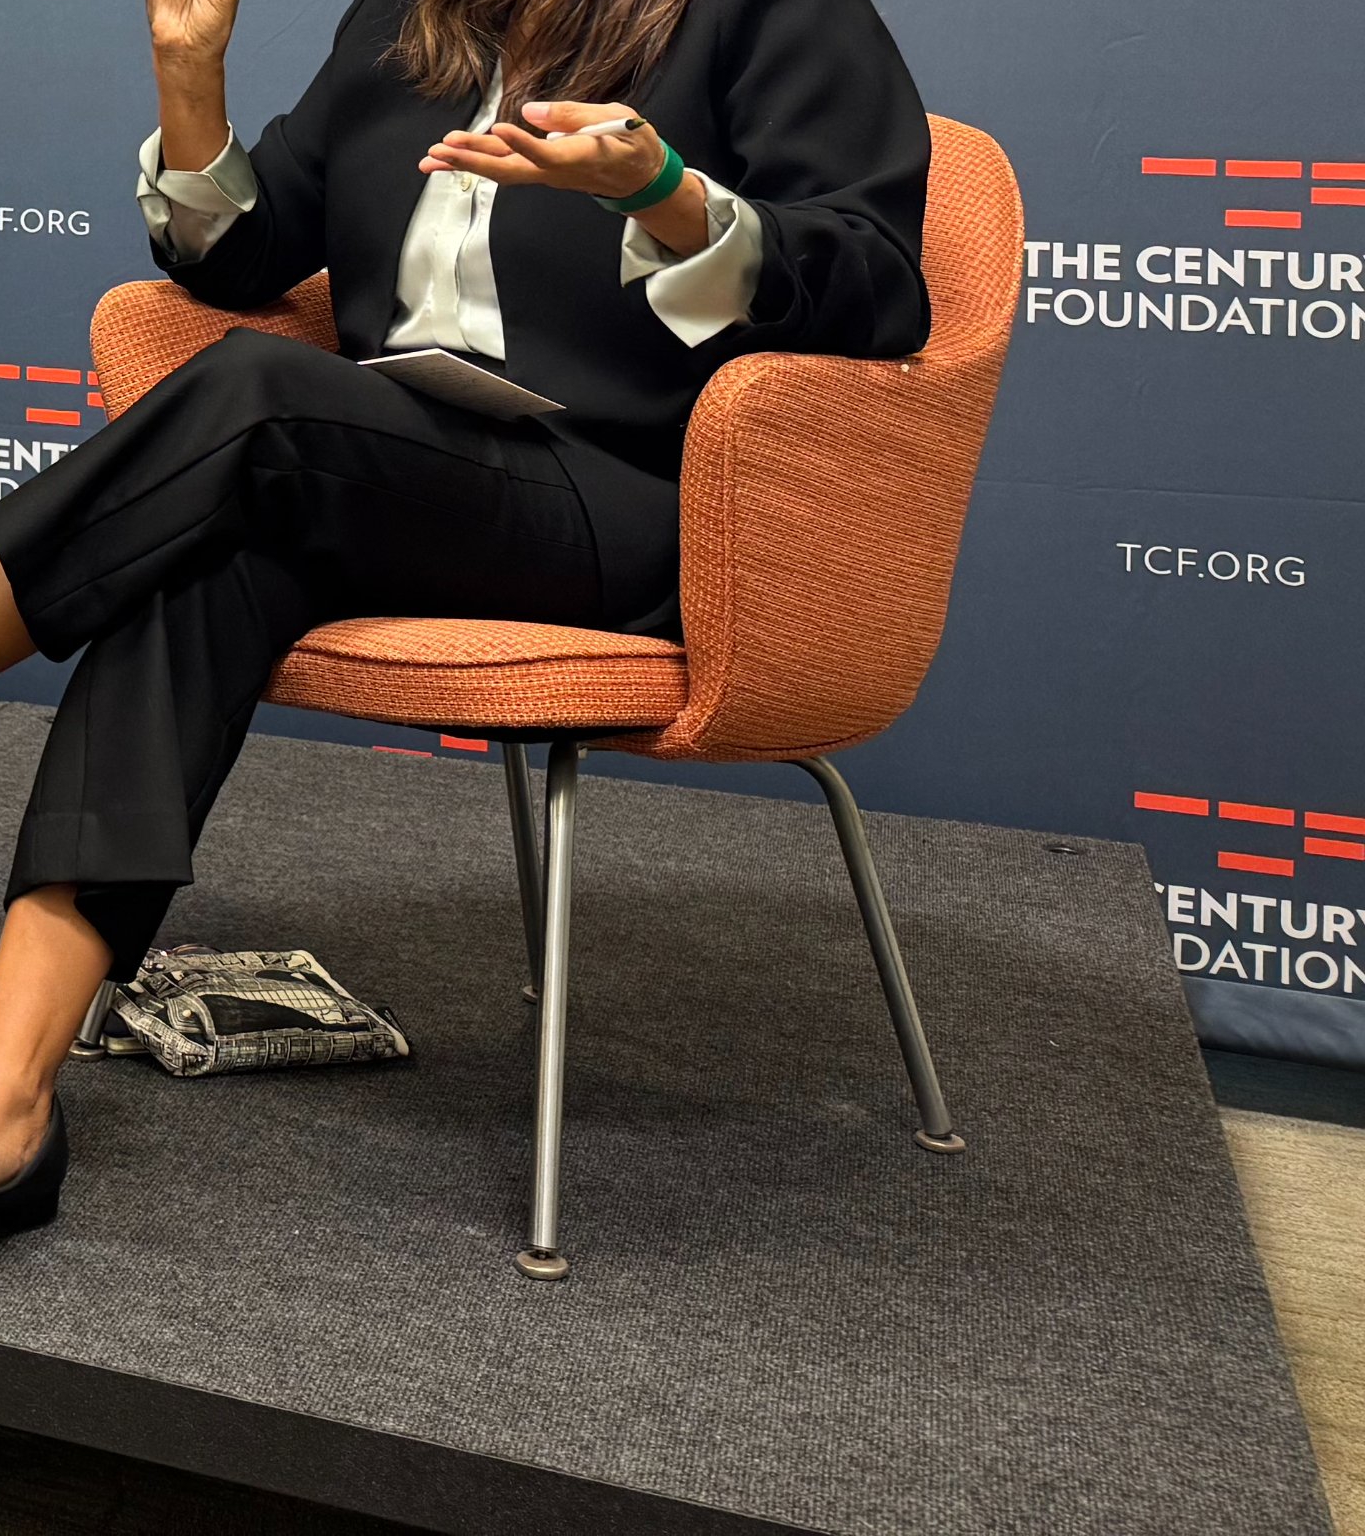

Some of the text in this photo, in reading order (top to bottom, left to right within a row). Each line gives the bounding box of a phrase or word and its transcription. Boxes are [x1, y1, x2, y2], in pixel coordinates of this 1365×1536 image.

[1024, 242, 1365, 292] THE CENTUR
[1117, 543, 1304, 586] TCF.ORG
[1154, 882, 1365, 946] ENTUR
[1174, 932, 1365, 993] DATION
